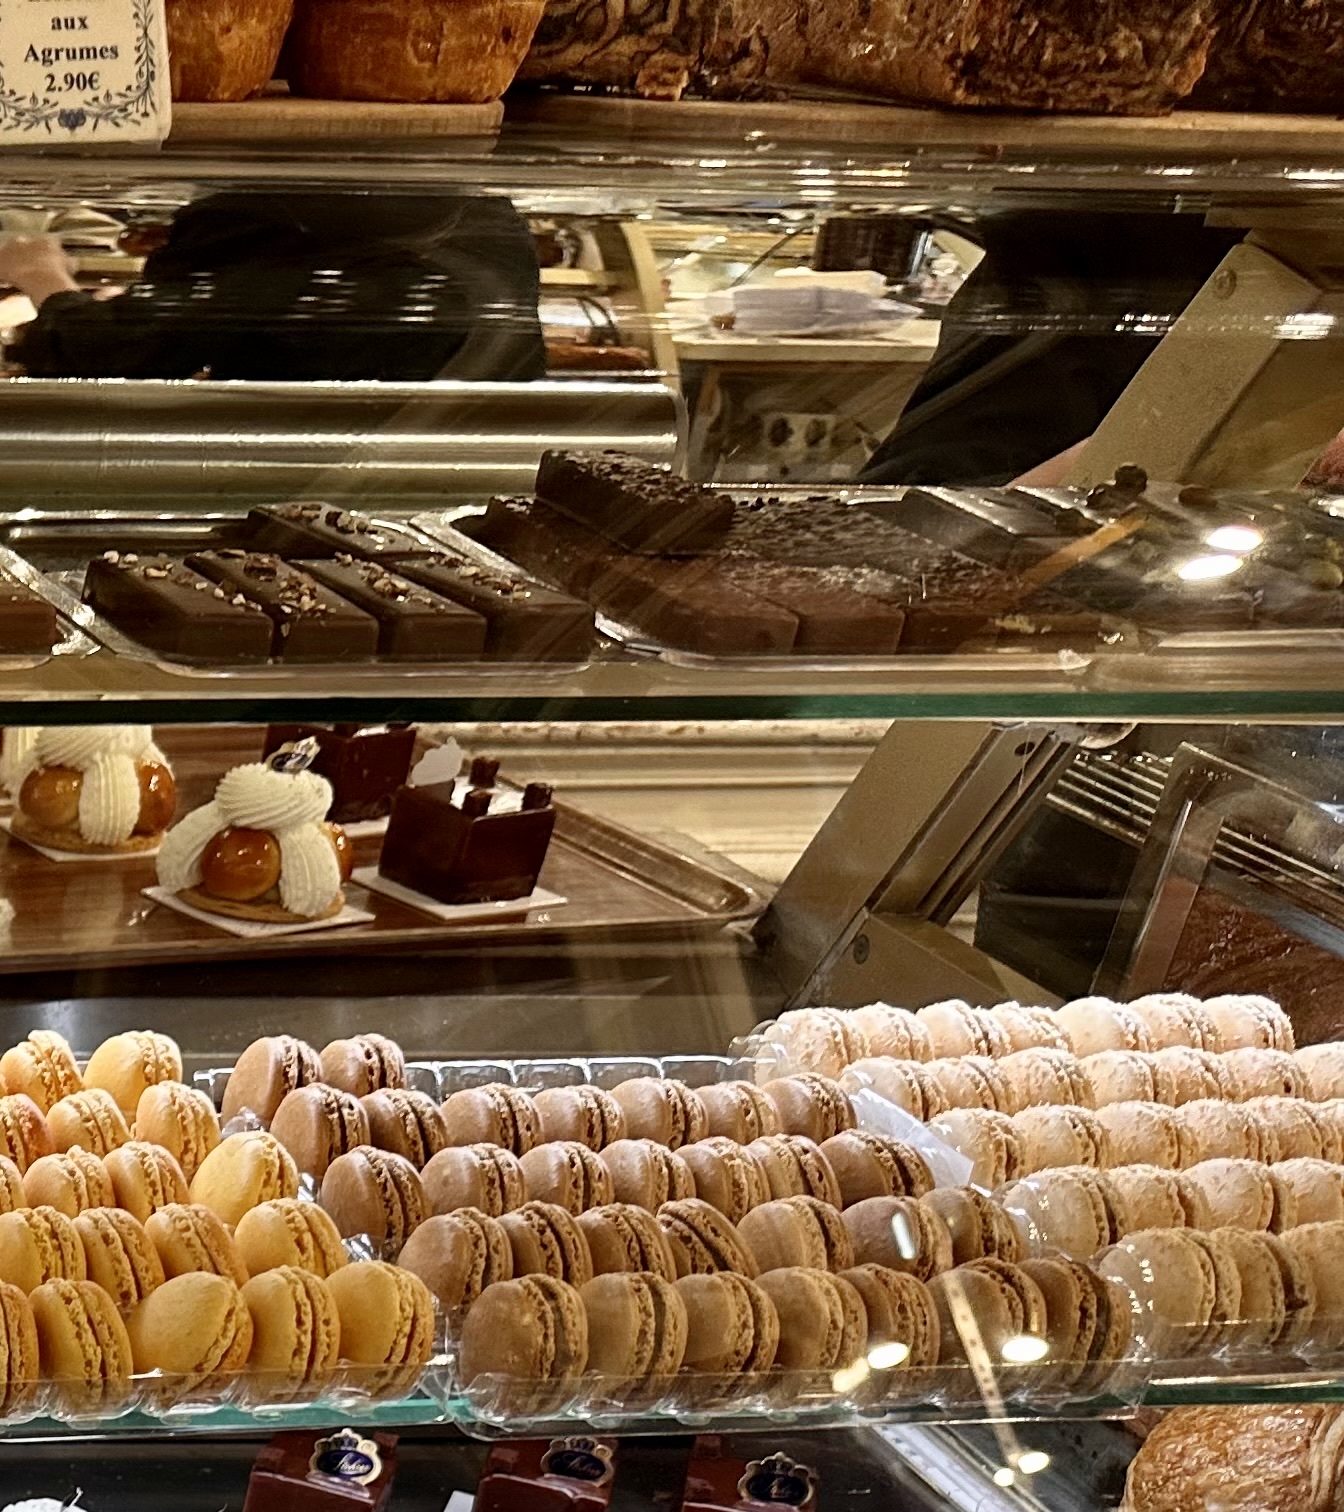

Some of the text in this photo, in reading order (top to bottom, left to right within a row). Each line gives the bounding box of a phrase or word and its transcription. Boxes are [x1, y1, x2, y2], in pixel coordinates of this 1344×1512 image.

[51, 16, 89, 31] aux
[24, 44, 119, 67] Agrumes
[44, 71, 101, 92] 2.90€
